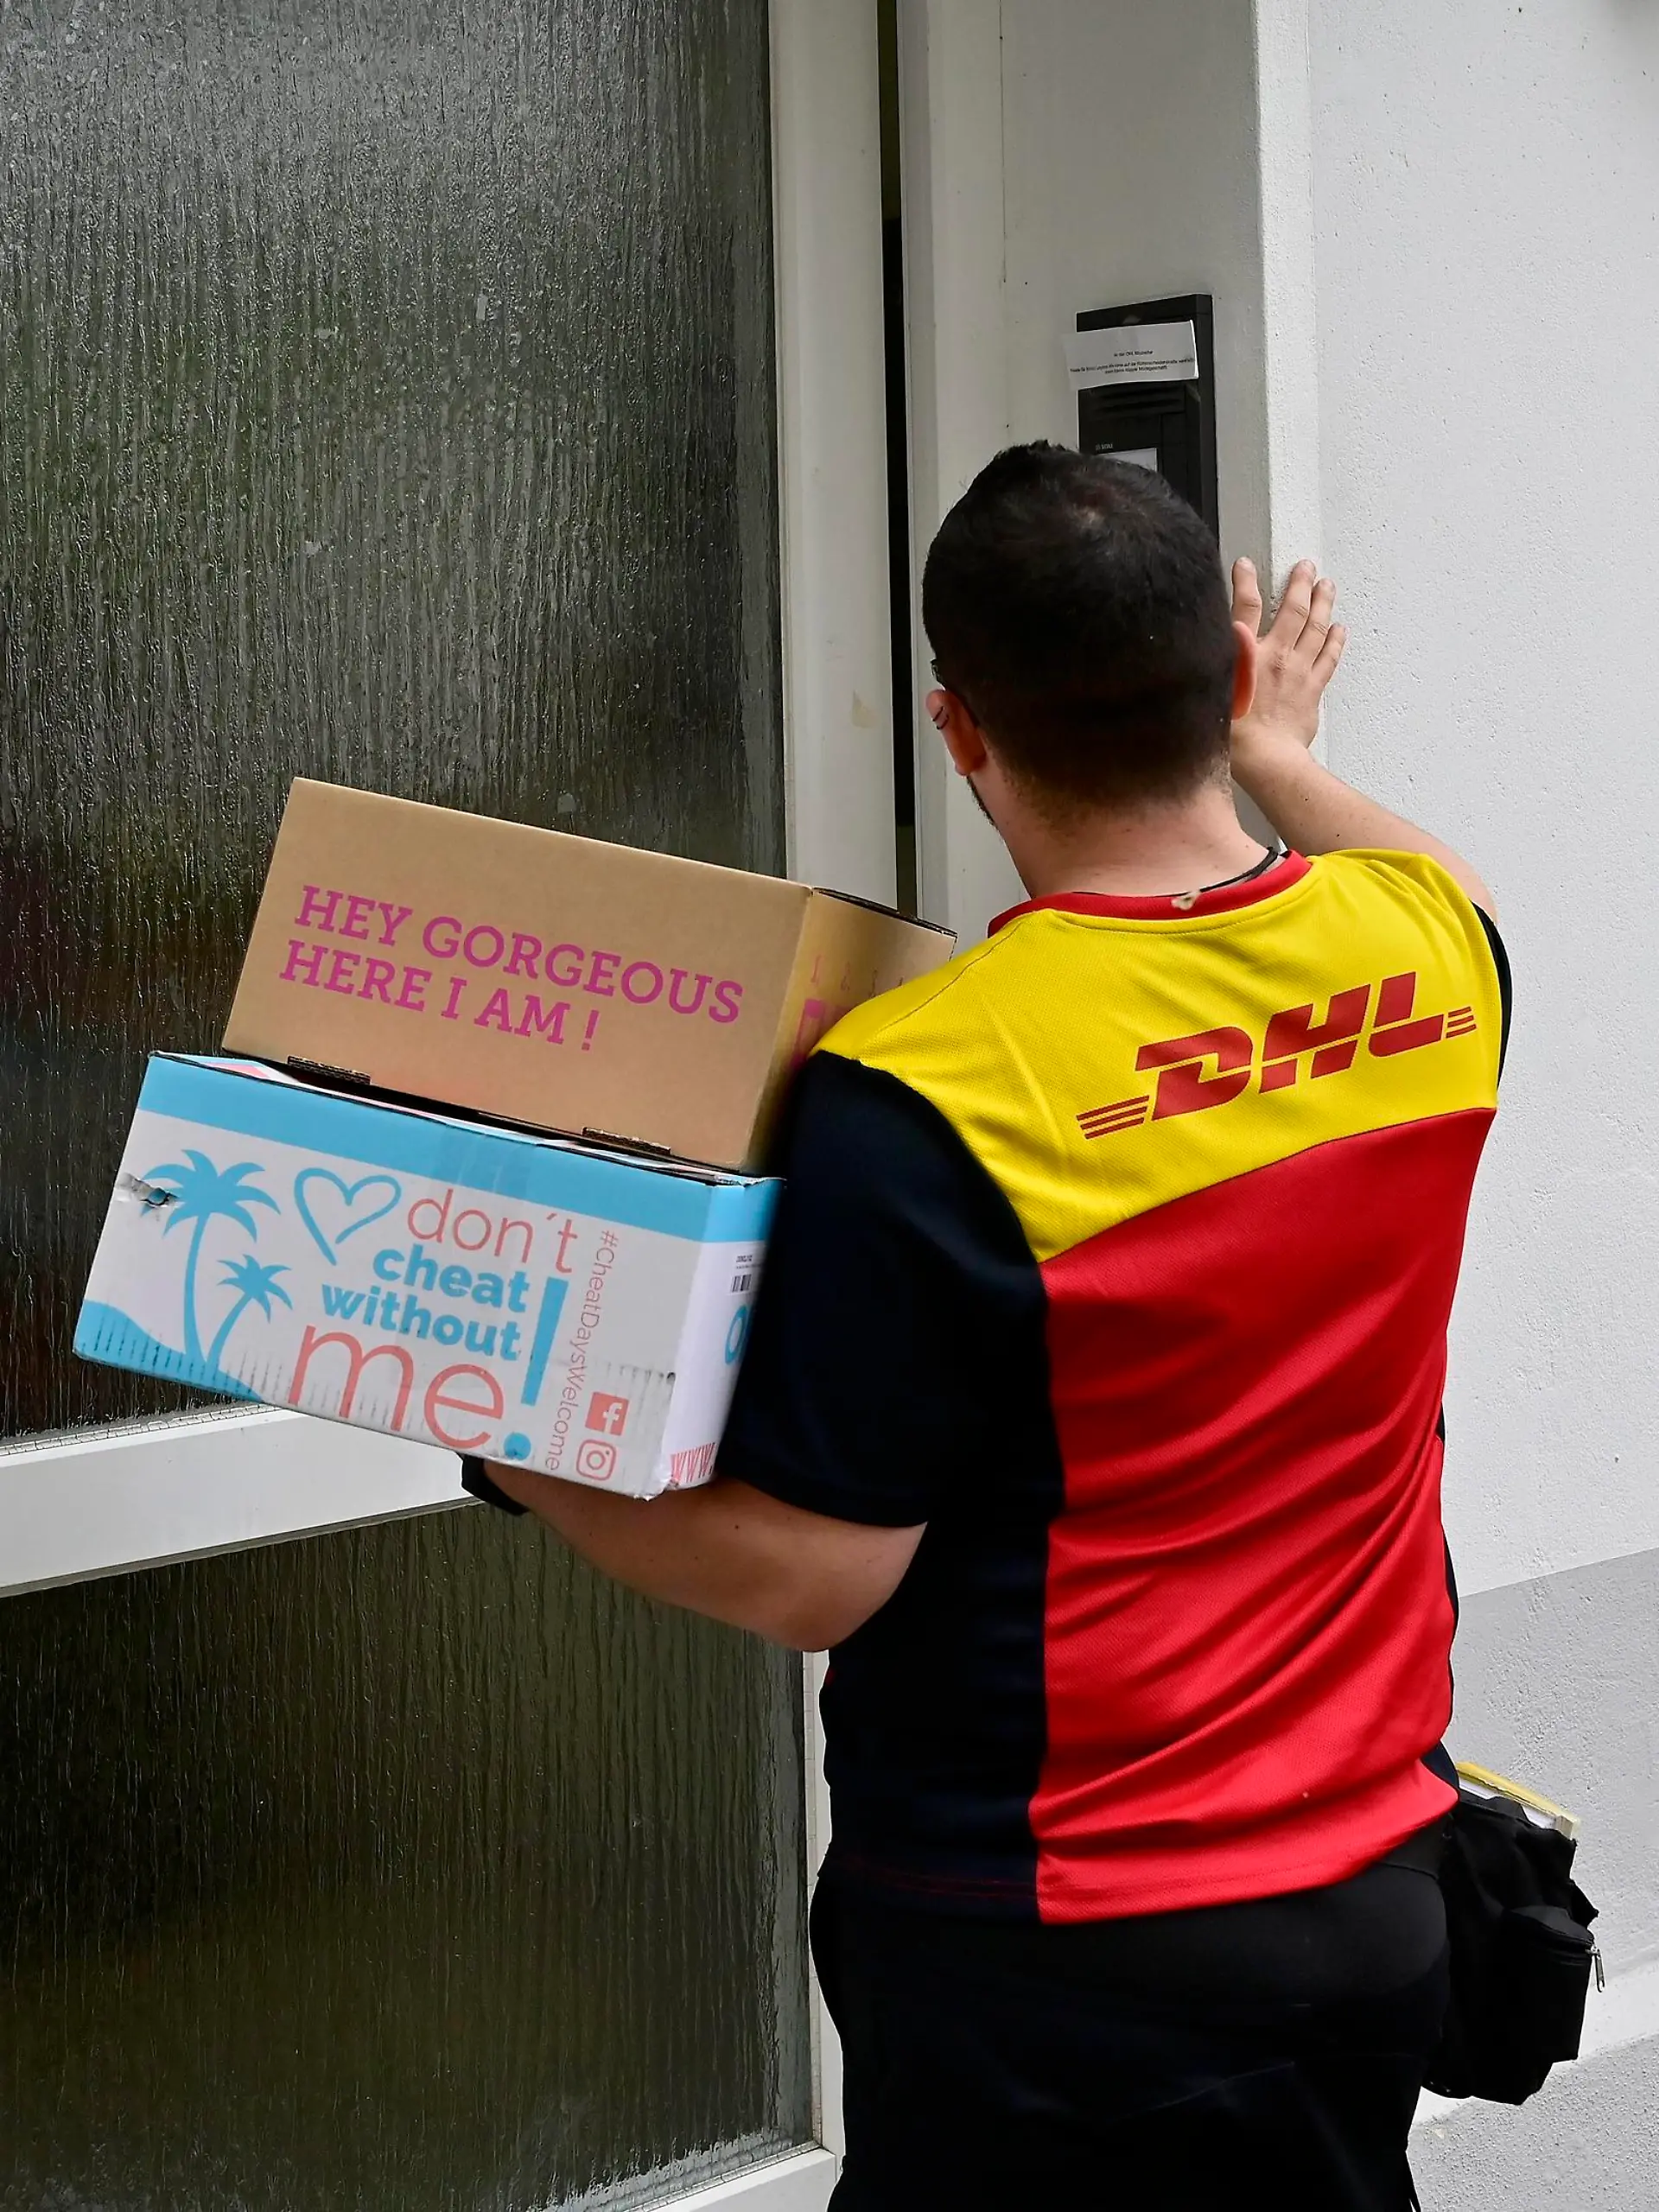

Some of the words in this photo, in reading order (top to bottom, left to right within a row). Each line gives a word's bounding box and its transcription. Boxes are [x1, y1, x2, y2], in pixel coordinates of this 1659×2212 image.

[280, 939, 432, 1011] HERE
[441, 977, 468, 1019] I
[474, 988, 573, 1045] AM
[296, 885, 413, 947] HEY
[423, 916, 744, 1024] GORGEOUS
[1135, 971, 1444, 1121] DHL
[322, 1284, 521, 1361] without
[372, 1244, 531, 1313] cheat
[544, 1230, 620, 1471] #CheatDaysWelcome
